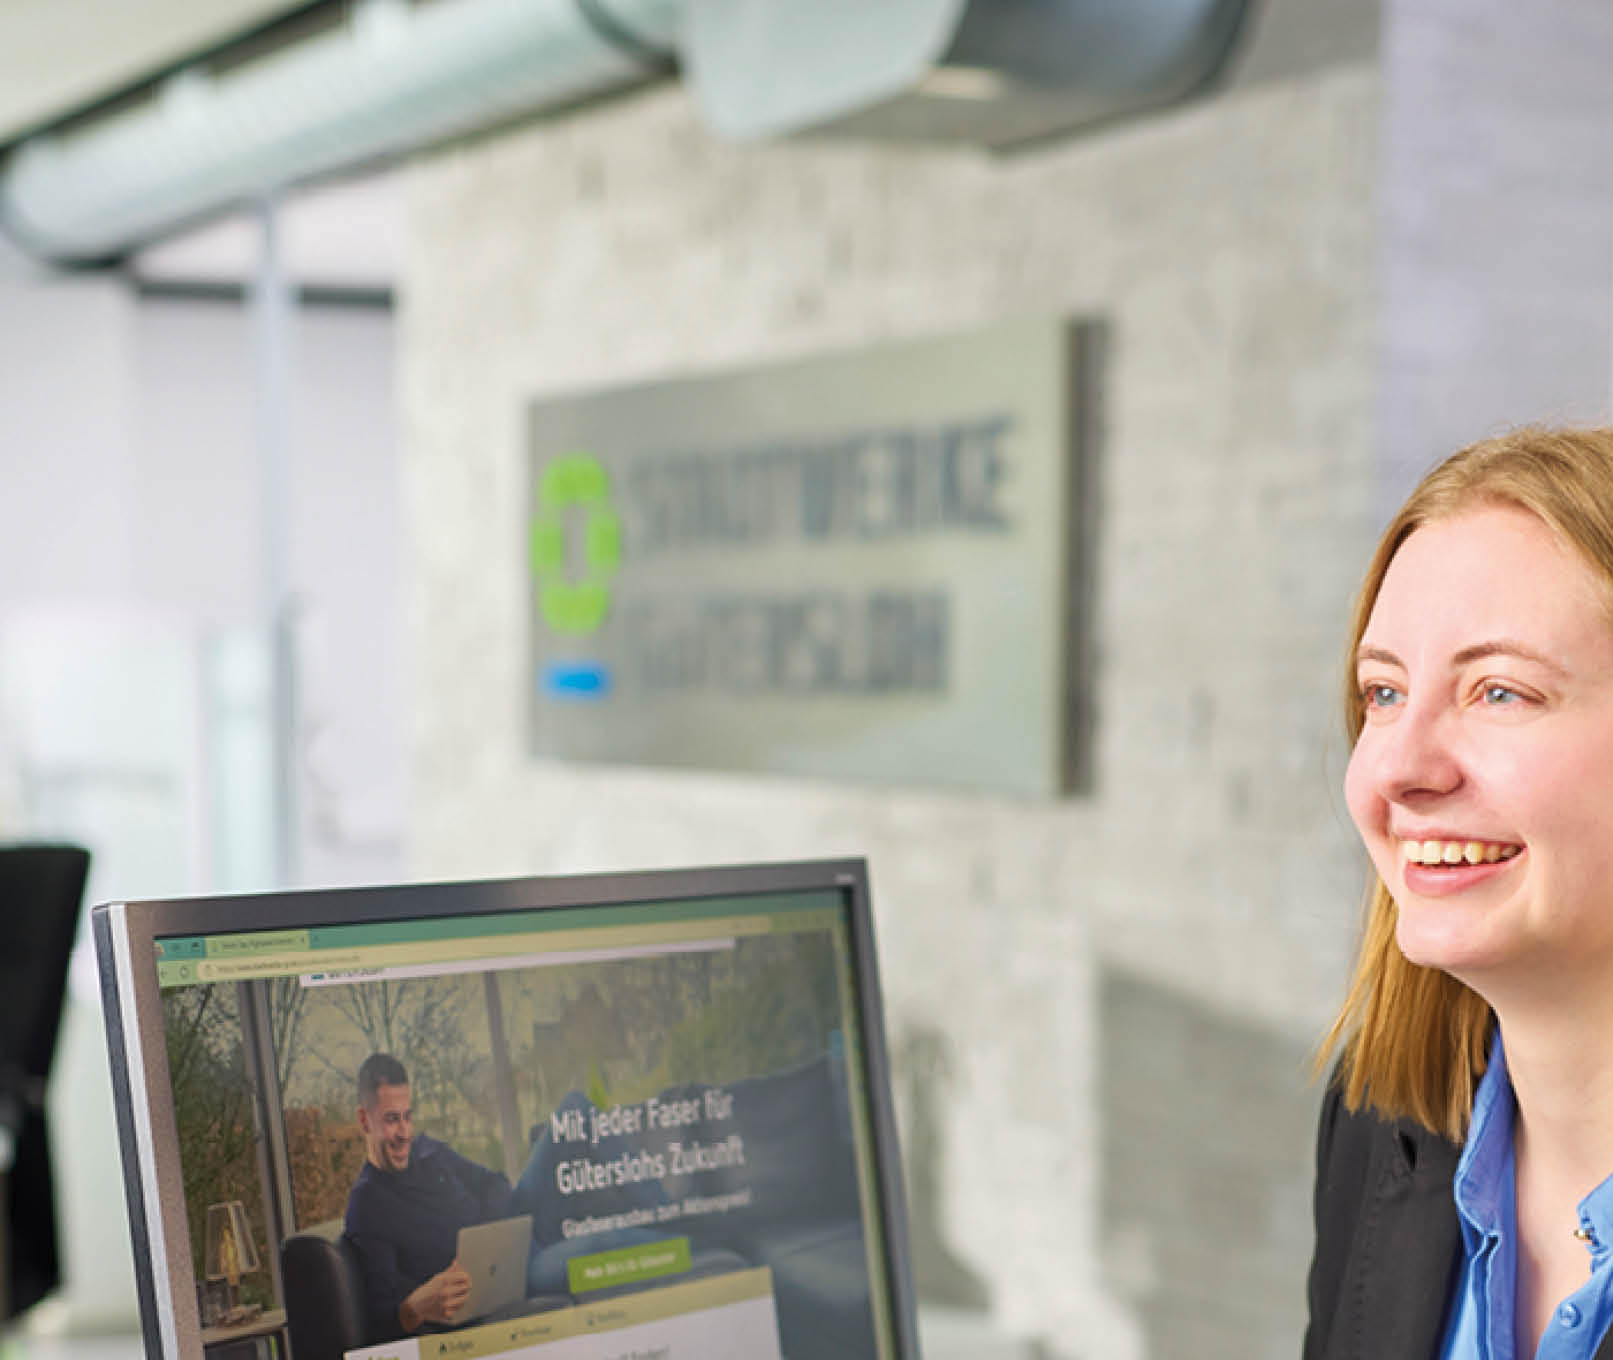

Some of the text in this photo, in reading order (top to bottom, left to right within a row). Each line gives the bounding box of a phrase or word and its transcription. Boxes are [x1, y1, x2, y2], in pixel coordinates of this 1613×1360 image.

[551, 1089, 733, 1144] Mit jeder Faser für
[557, 1135, 745, 1194] Güterslohs Zukunft
